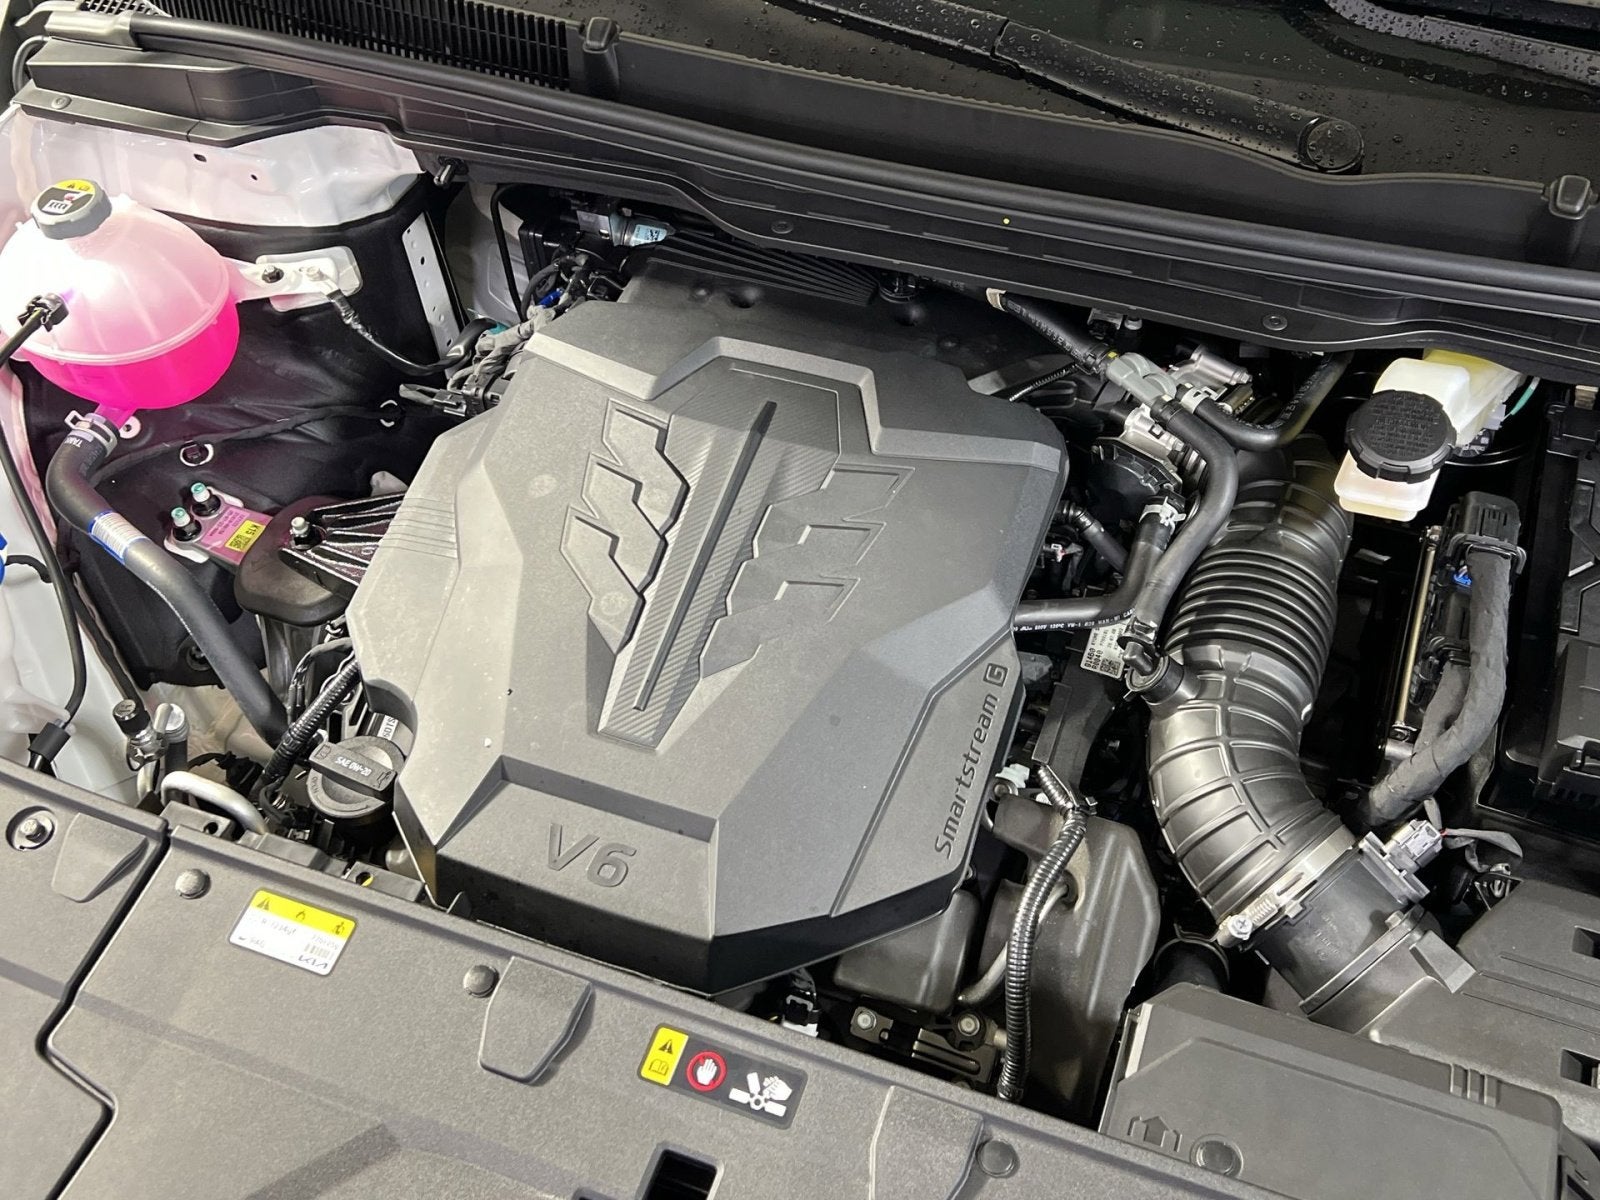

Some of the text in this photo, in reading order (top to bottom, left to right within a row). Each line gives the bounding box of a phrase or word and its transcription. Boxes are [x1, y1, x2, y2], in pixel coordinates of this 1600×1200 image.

[335, 756, 372, 776] SAE 0W-20
[933, 692, 1001, 861] Smartstream
[547, 821, 638, 888] V6
[298, 954, 328, 969] KIA
